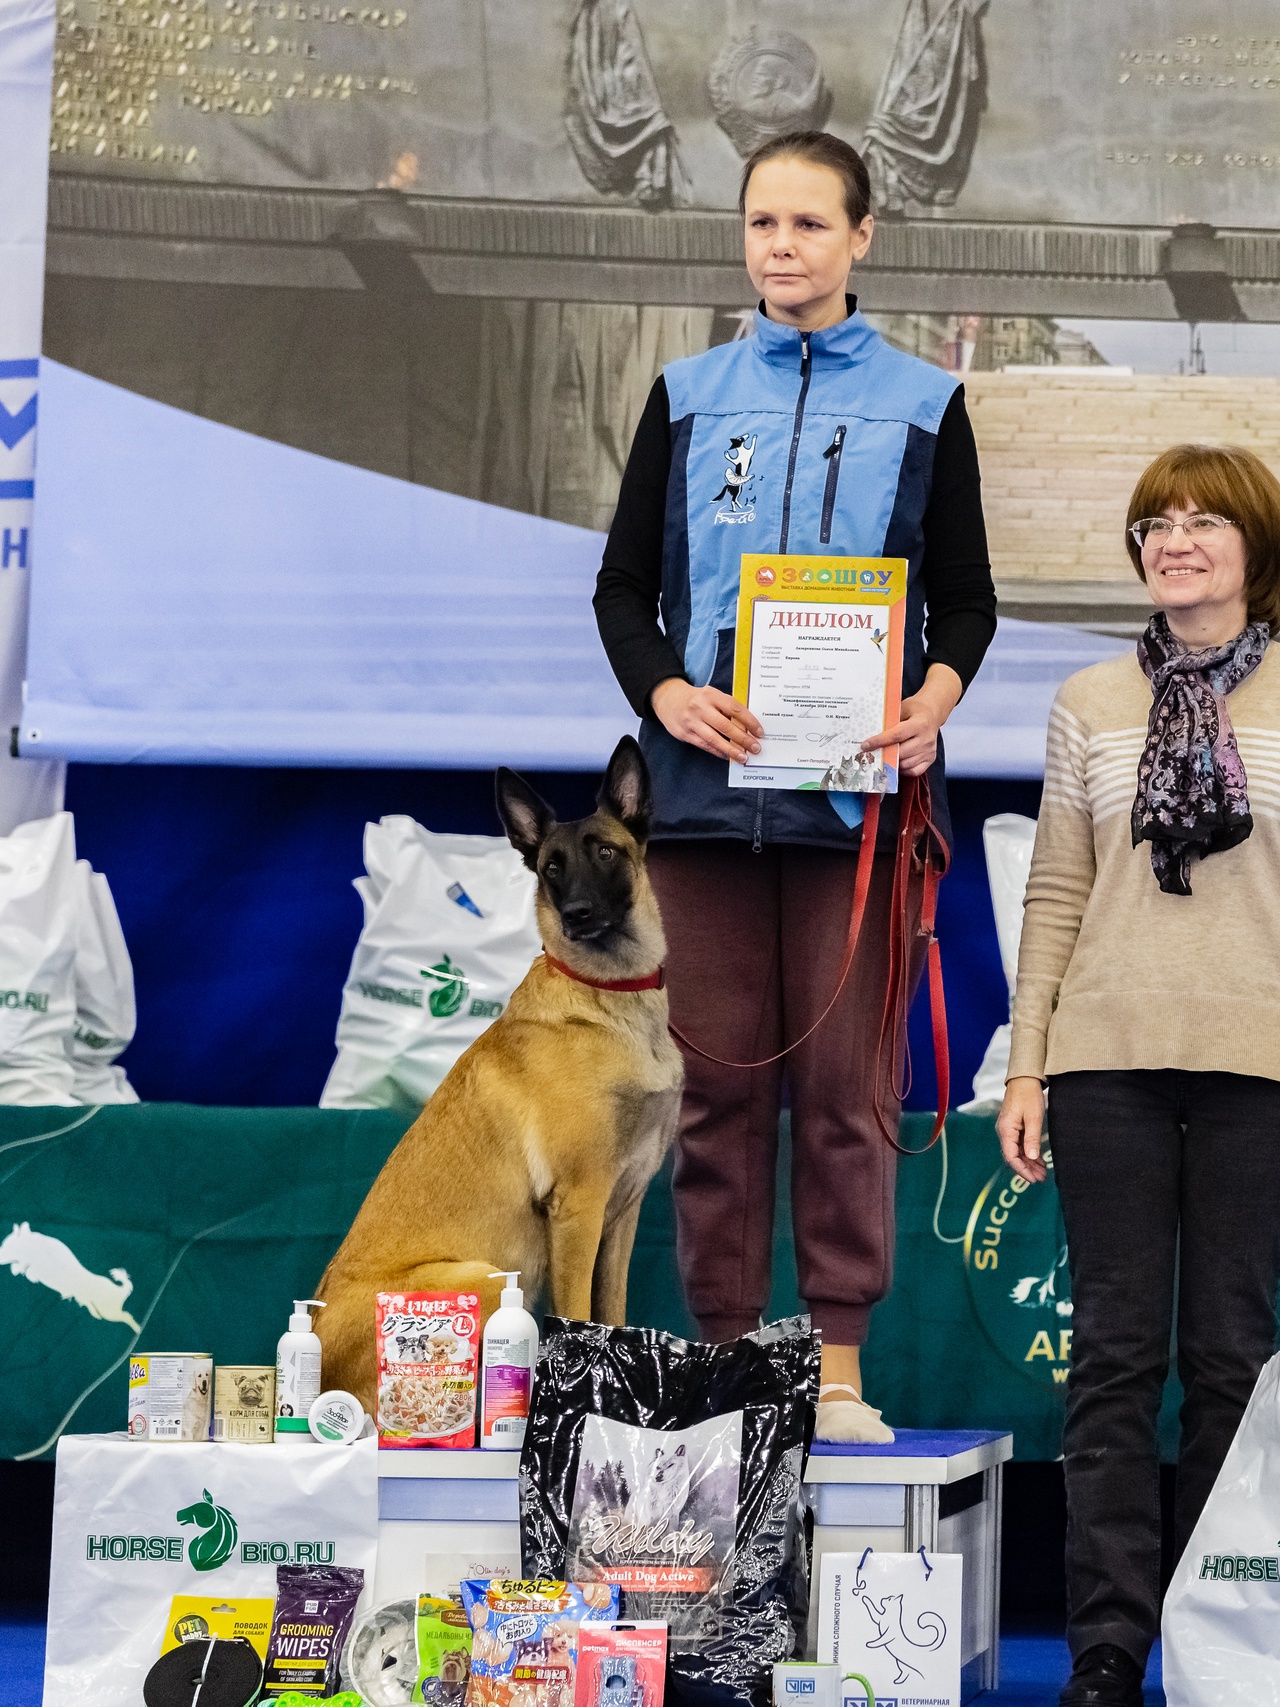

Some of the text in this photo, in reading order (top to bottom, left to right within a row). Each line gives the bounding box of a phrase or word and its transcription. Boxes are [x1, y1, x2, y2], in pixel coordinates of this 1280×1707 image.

[781, 567, 893, 586] ЗООШОУ
[769, 611, 873, 630] ДИПЛОМ
[244, 1410, 254, 1418] ДЛЯ
[255, 1410, 269, 1418] СОБАК
[86, 1535, 185, 1562] HORSE
[603, 1571, 695, 1583] Adult Dog Active
[1199, 1556, 1280, 1582] HORSE
[178, 1618, 201, 1635] PET
[280, 1623, 334, 1637] GROOMING
[426, 1631, 465, 1640] МЕДАЛЬОНЫ
[276, 1638, 331, 1657] WIPES
[901, 1698, 950, 1706] ВЕТЕРИНАРНАЯ
